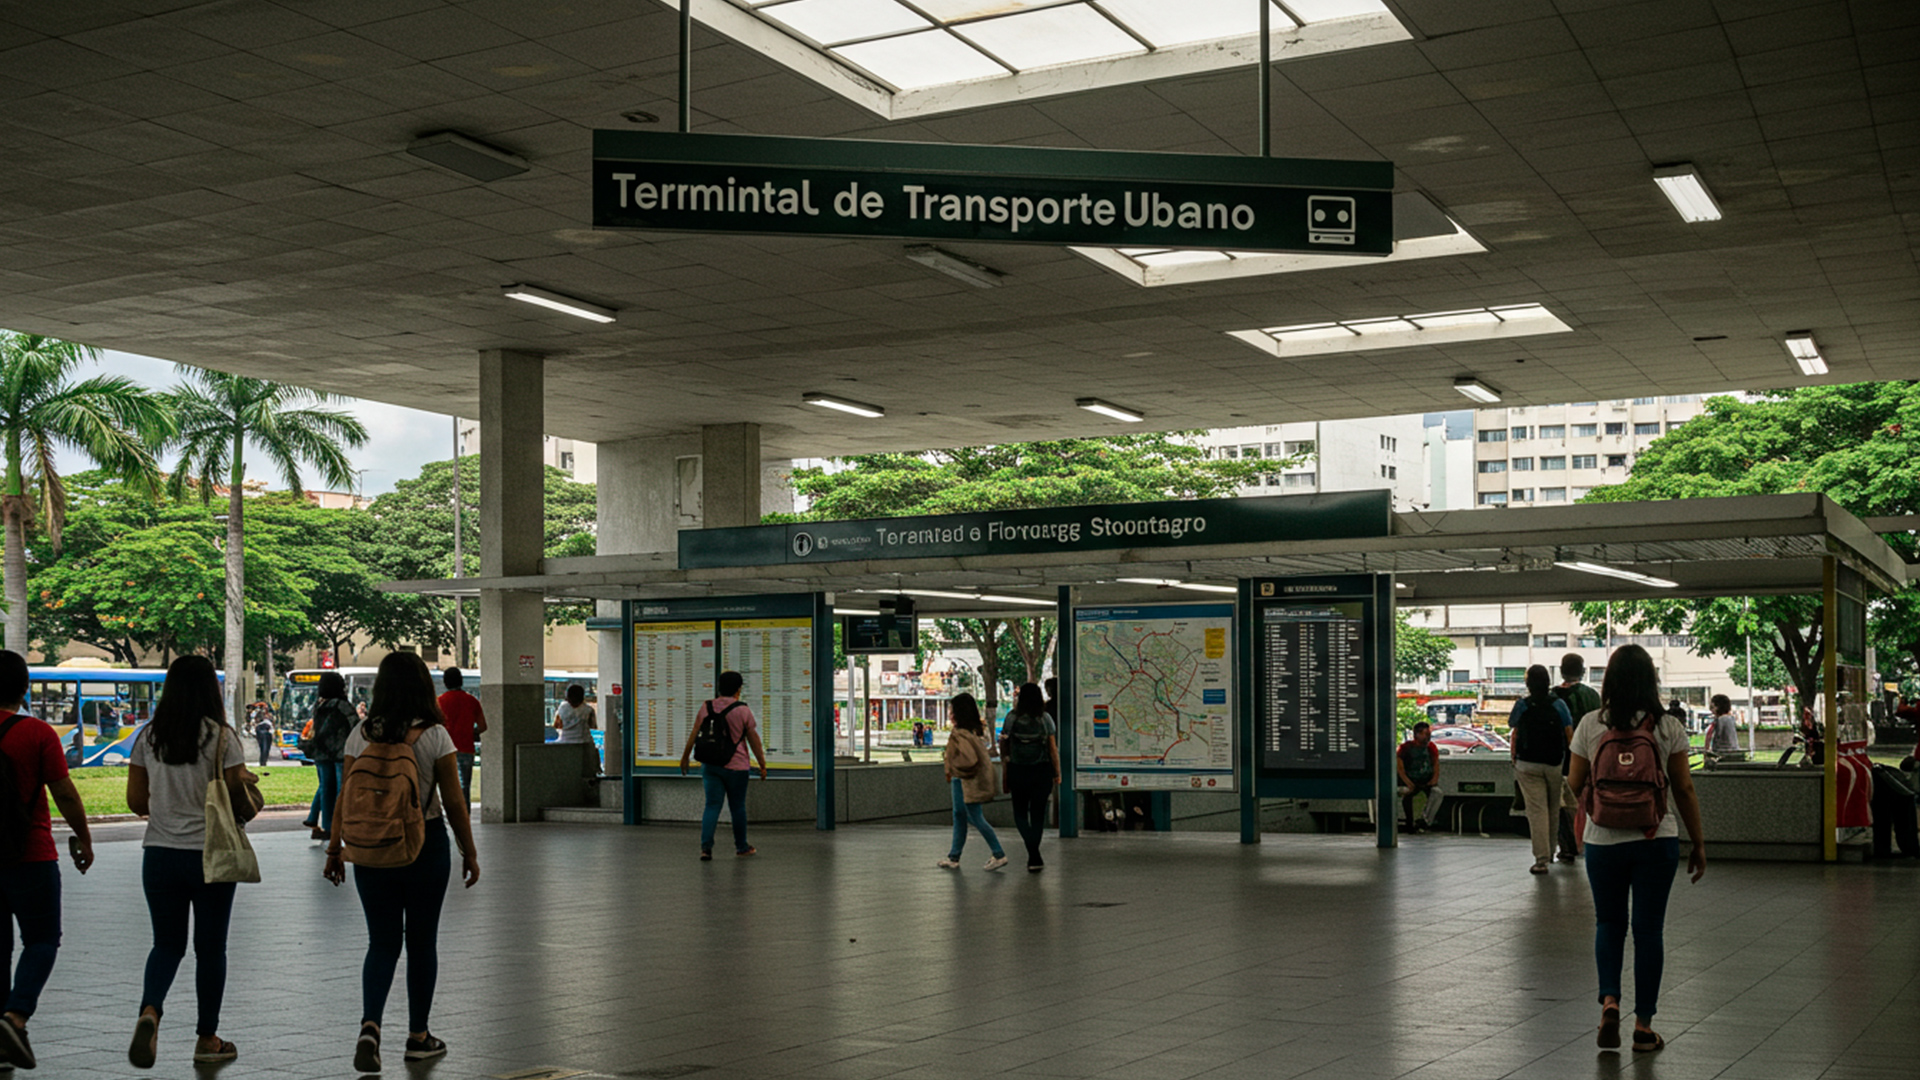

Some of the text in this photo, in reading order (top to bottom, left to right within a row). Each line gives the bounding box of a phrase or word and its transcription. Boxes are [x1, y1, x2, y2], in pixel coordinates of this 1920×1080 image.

[834, 182, 884, 218] de
[903, 185, 1116, 232] Transporte
[1124, 191, 1254, 230] Ubano
